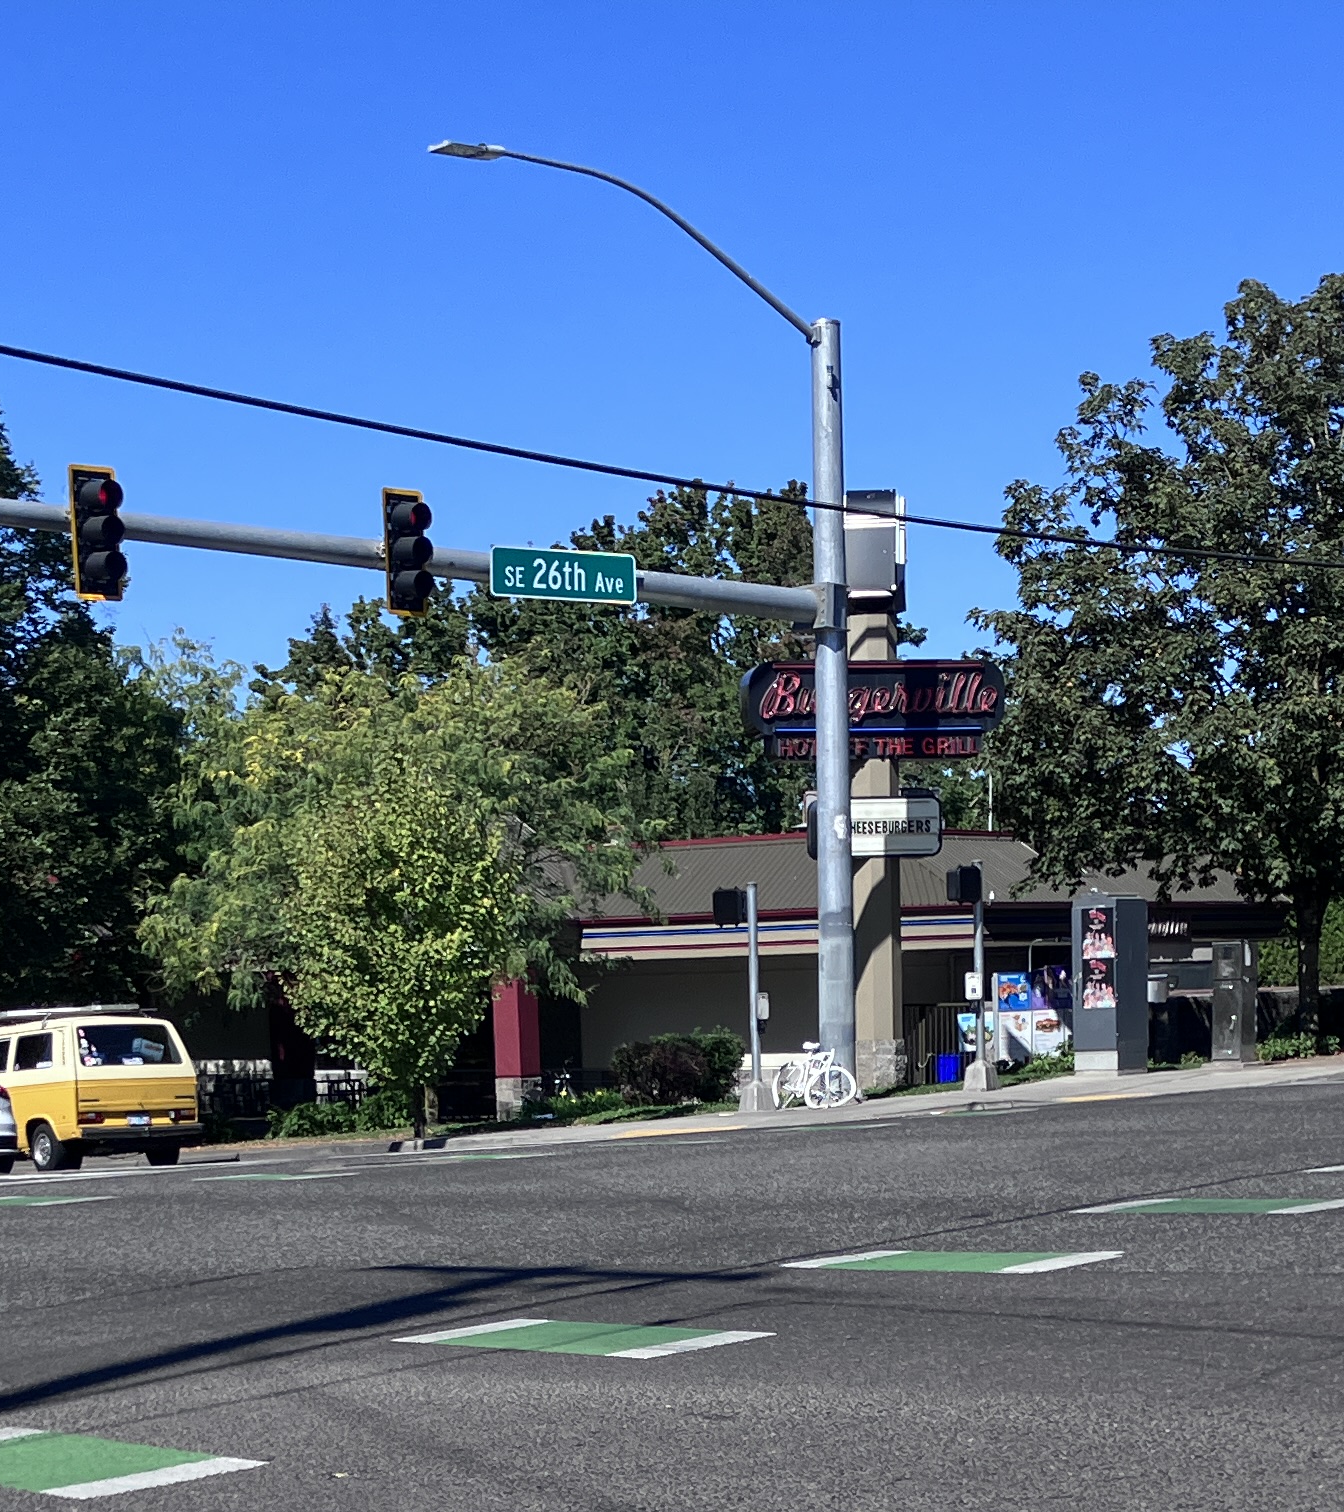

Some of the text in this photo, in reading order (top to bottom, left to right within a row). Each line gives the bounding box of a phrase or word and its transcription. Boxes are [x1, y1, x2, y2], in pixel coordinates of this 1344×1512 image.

[504, 558, 624, 594] SE 26th Ave
[759, 670, 998, 723] Bugerville
[872, 736, 914, 756] THE
[922, 736, 980, 755] GRILL
[850, 819, 931, 835] HEESEBURGERS
